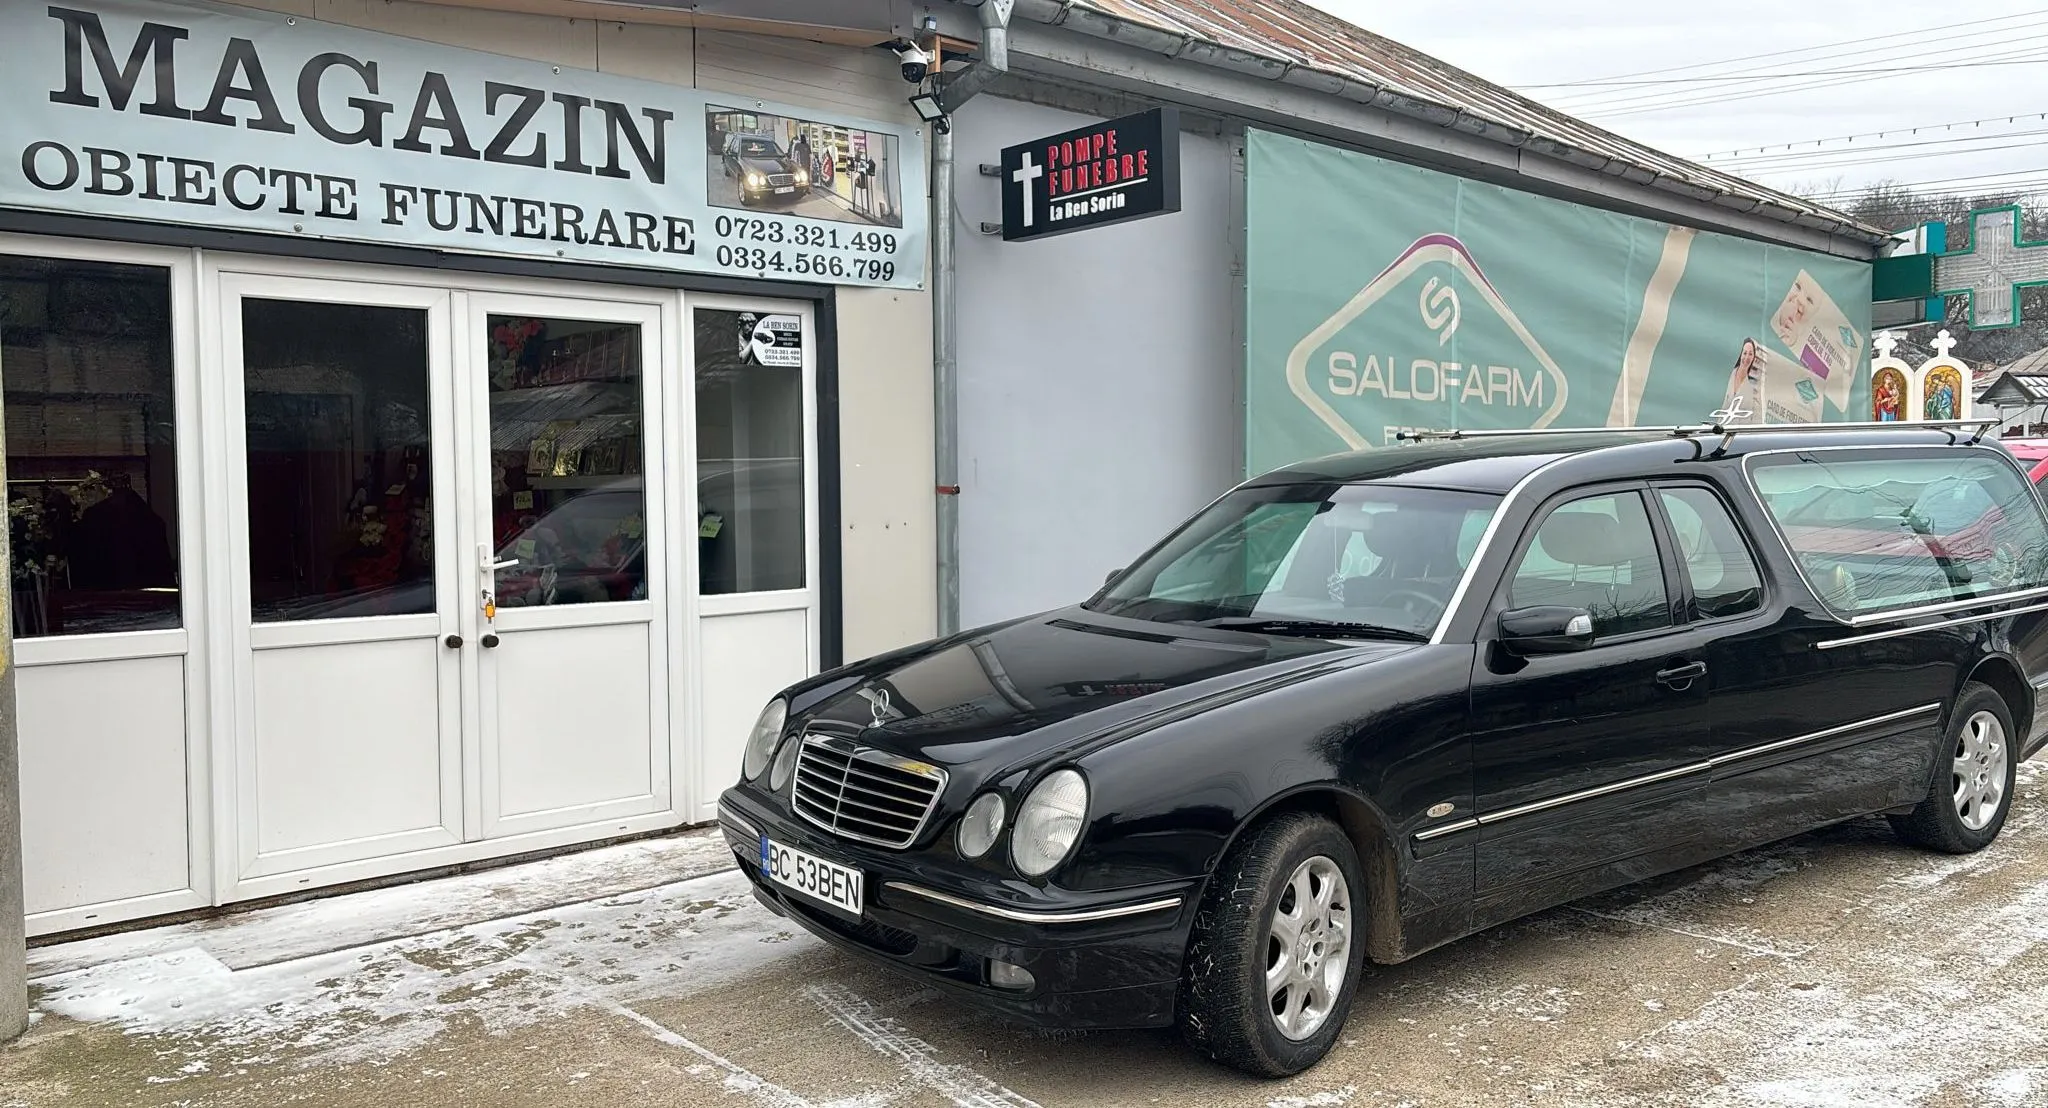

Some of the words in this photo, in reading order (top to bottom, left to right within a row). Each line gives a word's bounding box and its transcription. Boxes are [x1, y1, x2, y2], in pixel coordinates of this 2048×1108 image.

[48, 6, 674, 185] MAGAZIN
[1048, 129, 1117, 170] POMPE
[1049, 150, 1148, 196] FUNEBRE
[21, 140, 358, 221] OBIECTE
[379, 183, 695, 256] FUNERARE
[1050, 205, 1063, 221] La
[1065, 201, 1088, 217] Ben
[1090, 192, 1125, 213] Sorin
[715, 215, 897, 254] 0723.321.499
[716, 245, 895, 281] 0334.566.799
[1328, 351, 1543, 408] SALOFARM
[769, 844, 790, 880] BC
[796, 855, 859, 909] 53BEN
